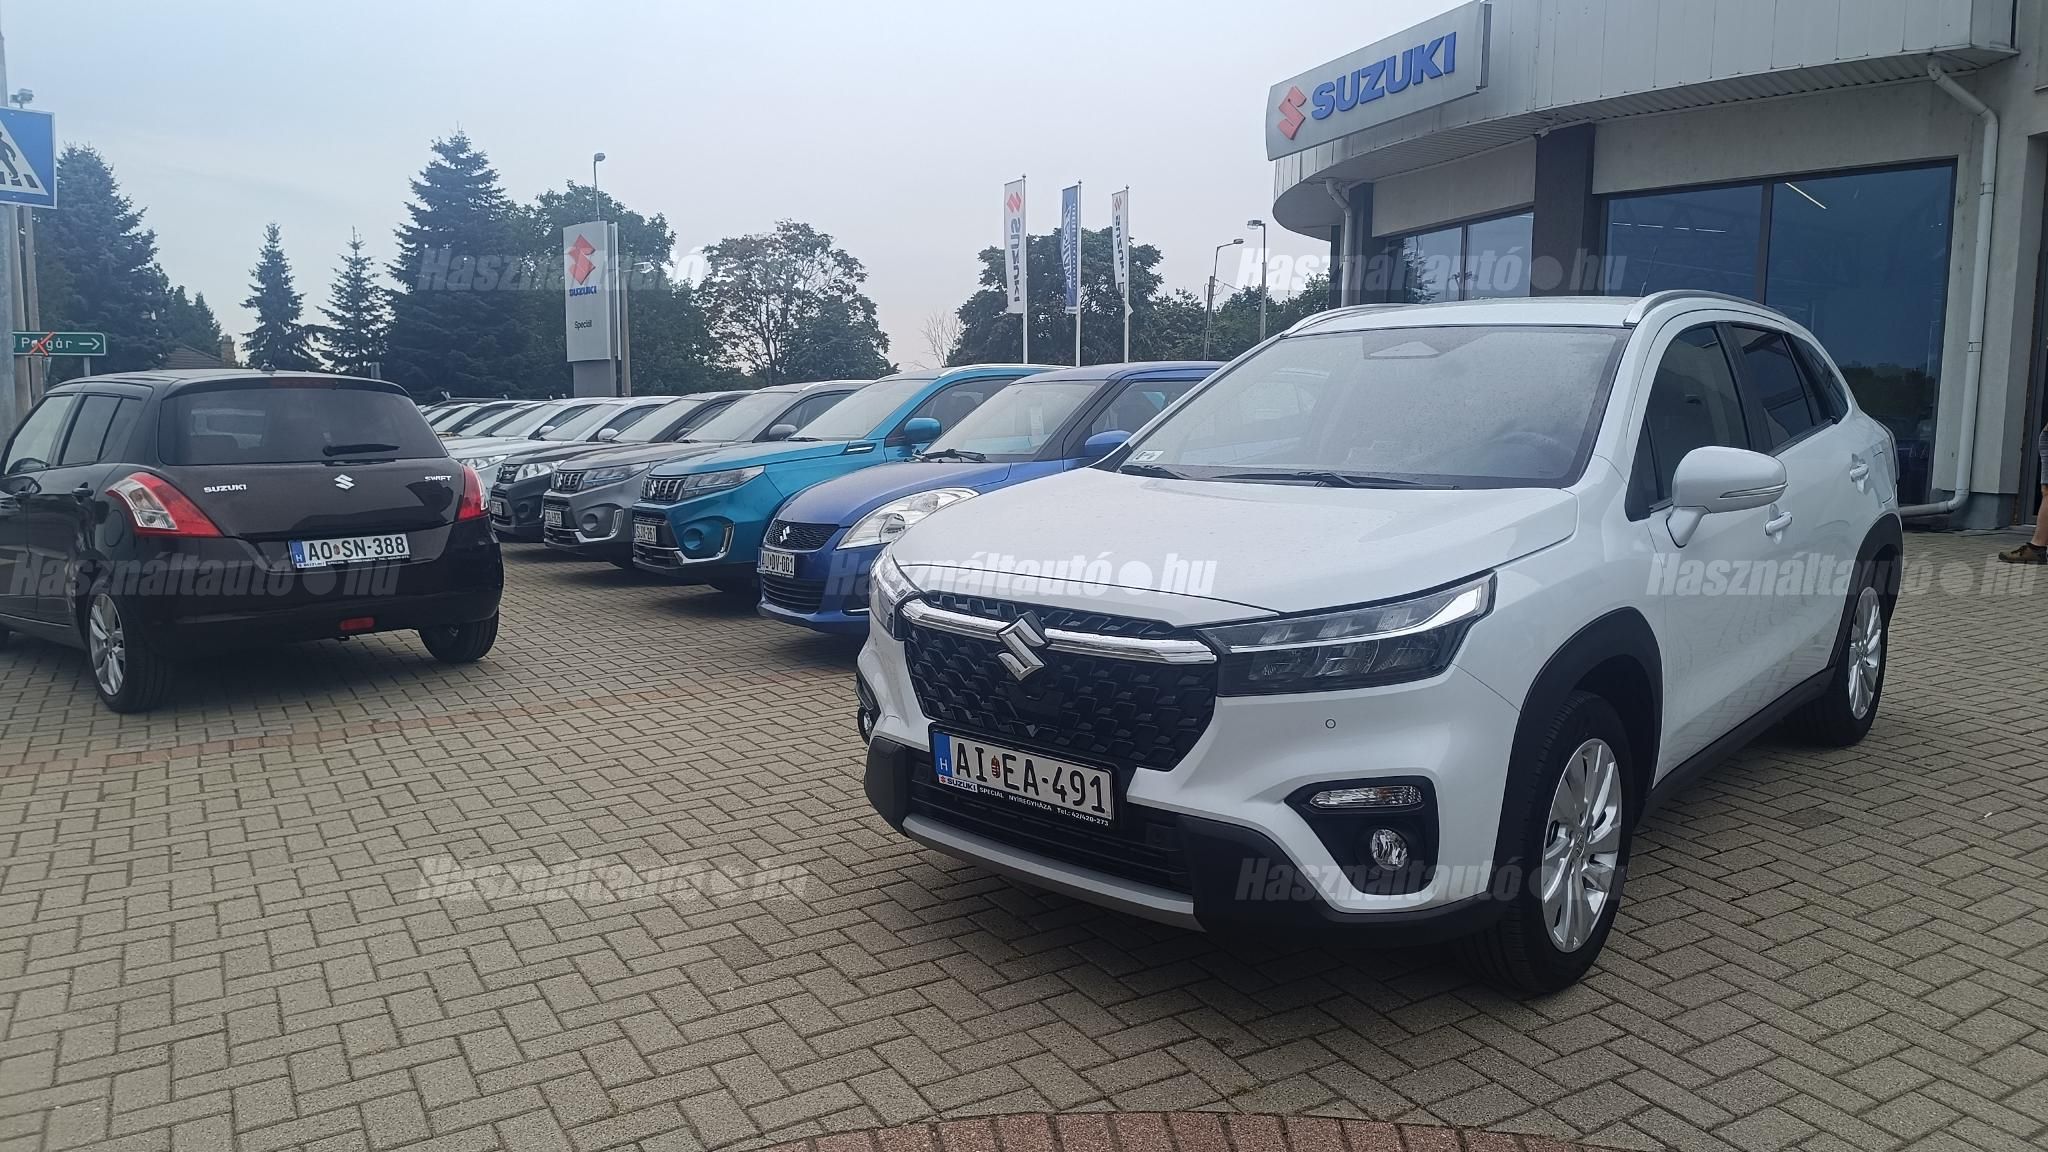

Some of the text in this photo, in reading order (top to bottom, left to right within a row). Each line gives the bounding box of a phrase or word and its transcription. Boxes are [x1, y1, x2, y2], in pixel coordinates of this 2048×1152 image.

[1311, 31, 1456, 120] SUZUKI
[569, 286, 597, 296] SUZUKI
[21, 335, 73, 351] Pgár
[203, 484, 247, 493] SUZUKI
[341, 536, 406, 558] SN-388
[940, 742, 1106, 814] H AI EA-491
[947, 778, 977, 791] SUZUKI
[979, 787, 1004, 798] SPECIAL
